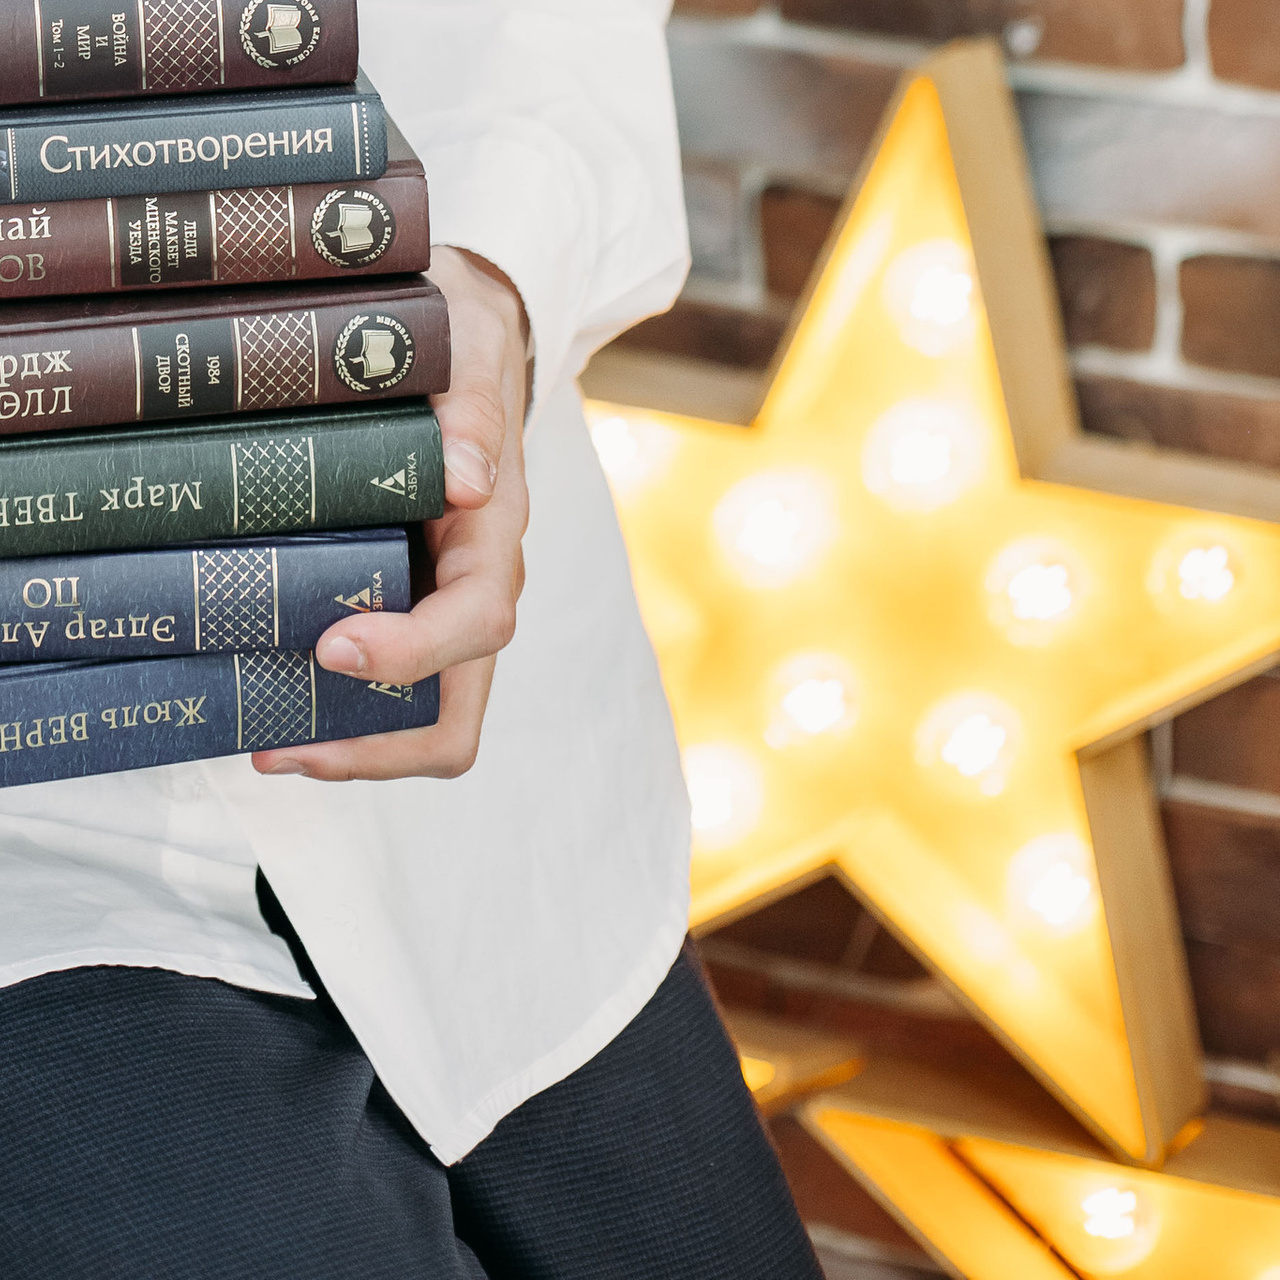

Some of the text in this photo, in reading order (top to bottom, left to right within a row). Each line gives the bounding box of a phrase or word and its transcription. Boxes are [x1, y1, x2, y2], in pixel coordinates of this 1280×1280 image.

[75, 24, 91, 61] МИР
[95, 35, 108, 47] И
[111, 12, 129, 67] ВОЙНА
[39, 127, 333, 173] Стихотворения
[129, 219, 142, 265] УЕЗДА
[145, 197, 161, 283] МЦЕНСКОГО
[164, 211, 180, 269] МАКБЕТ
[183, 220, 198, 258] ЛЕДИ
[156, 355, 170, 393] ДВОР
[175, 333, 194, 408] СКОТНЫЙ
[207, 354, 221, 386] 1984
[100, 476, 202, 512] Марк
[407, 451, 418, 501] АЗБУКА
[21, 576, 80, 609] ПО
[371, 570, 384, 611] ЗБУКА
[65, 611, 176, 642] Эдгар
[101, 695, 207, 729] Жюль
